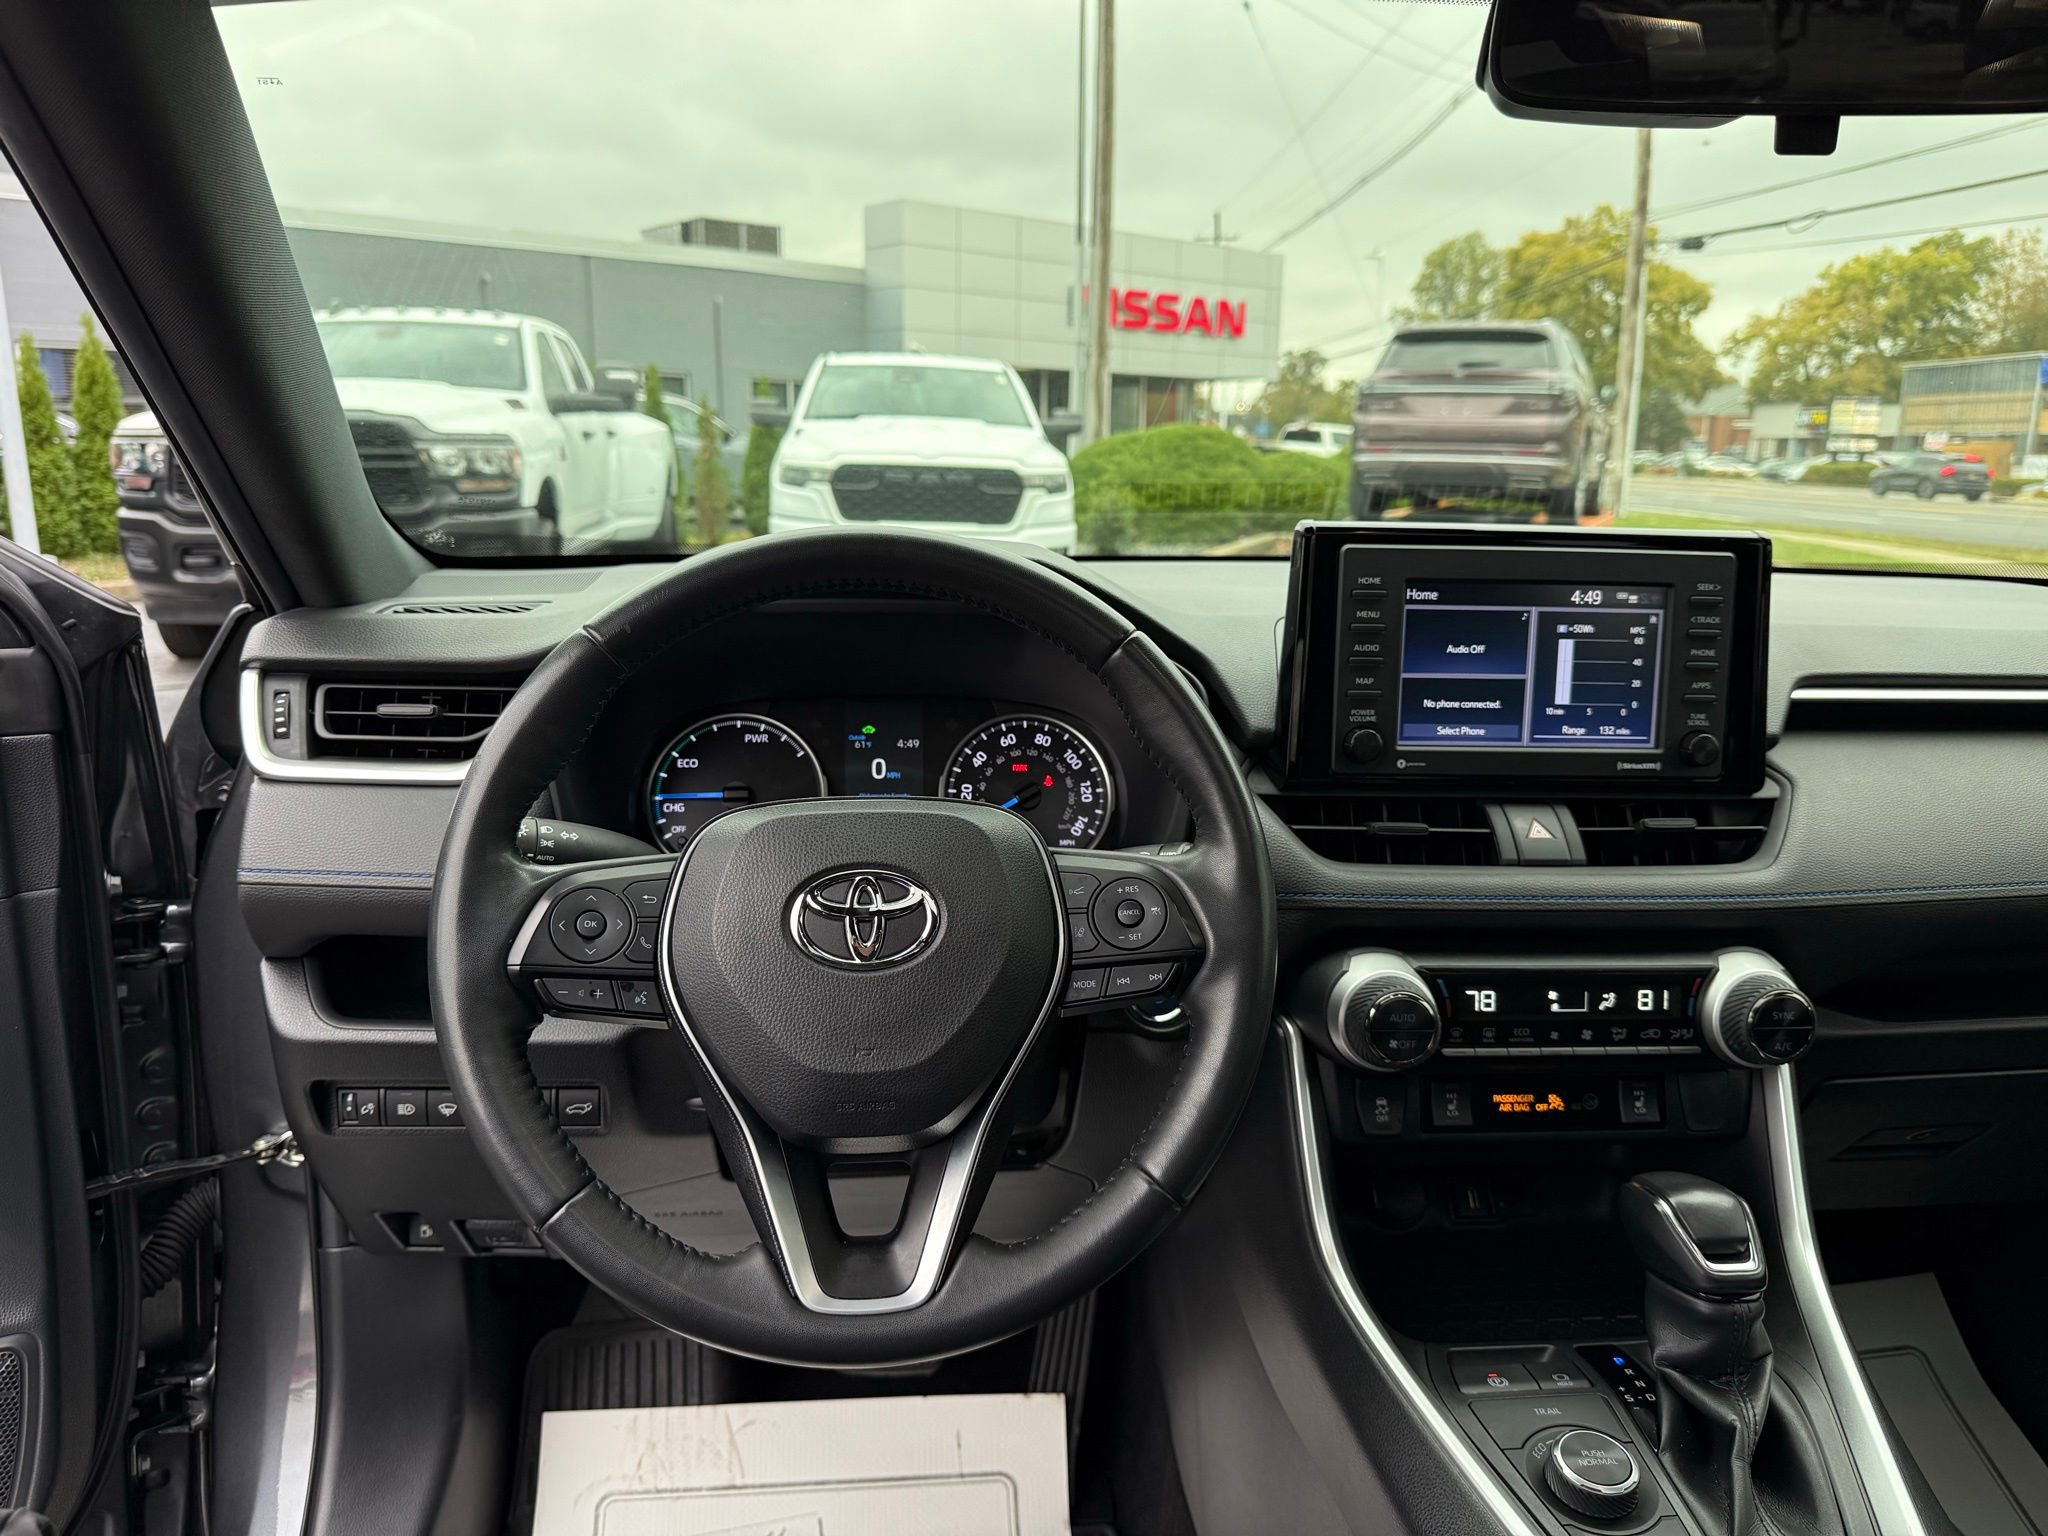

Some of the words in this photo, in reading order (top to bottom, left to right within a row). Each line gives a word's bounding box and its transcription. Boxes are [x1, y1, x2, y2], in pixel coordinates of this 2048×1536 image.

[1082, 285, 1246, 339] ISSAN
[1358, 577, 1382, 585] HOME
[1406, 588, 1439, 600] Home
[1570, 590, 1602, 605] 4:49
[1630, 627, 1646, 635] MPG
[1634, 637, 1644, 645] 60
[1354, 644, 1380, 652] AUDIO
[1446, 645, 1469, 654] Audio
[1470, 645, 1486, 654] Off
[1690, 649, 1716, 657] PHONE
[1632, 658, 1643, 667] 40
[1355, 677, 1375, 685] MAP
[1631, 680, 1641, 688] 20
[1691, 682, 1712, 690] APPS
[1423, 699, 1436, 709] No
[1436, 700, 1460, 710] phone
[1631, 701, 1638, 709] 0
[1586, 708, 1592, 716] 5
[1621, 709, 1627, 717] 0
[1436, 726, 1459, 735] Select
[1460, 726, 1486, 735] Phone
[1562, 726, 1587, 736] Range
[1600, 726, 1615, 735] 132
[744, 734, 769, 743] PWR
[1000, 733, 1017, 747] 60
[1034, 733, 1052, 747] 80
[897, 739, 920, 748] 4:49
[677, 759, 699, 768] ECO
[972, 751, 988, 768] 40
[1063, 748, 1082, 770] 100
[871, 757, 887, 780] 0
[961, 784, 973, 800] 20
[1080, 780, 1093, 803] 120
[663, 803, 686, 812] CHG
[1071, 816, 1089, 837] 140
[536, 854, 555, 862] AUTO
[583, 920, 598, 928] OK
[1073, 980, 1097, 988] MODE
[1465, 990, 1496, 1012] 78
[1637, 989, 1670, 1011] 81
[1389, 1014, 1416, 1022] AUTO
[1772, 1011, 1795, 1020] SYNC
[1513, 1028, 1530, 1036] ECO
[1398, 1040, 1417, 1048] OFF
[1775, 1042, 1793, 1051] A/C
[1493, 1095, 1535, 1103] PASSENGER
[1499, 1103, 1513, 1111] AIR
[1513, 1103, 1530, 1111] BAG
[1624, 1368, 1635, 1376] R
[1624, 1394, 1635, 1402] S
[1645, 1393, 1656, 1401] D
[1534, 1407, 1562, 1415] TRAIL
[1532, 1442, 1547, 1459] ECO
[1581, 1449, 1605, 1457] PUSH
